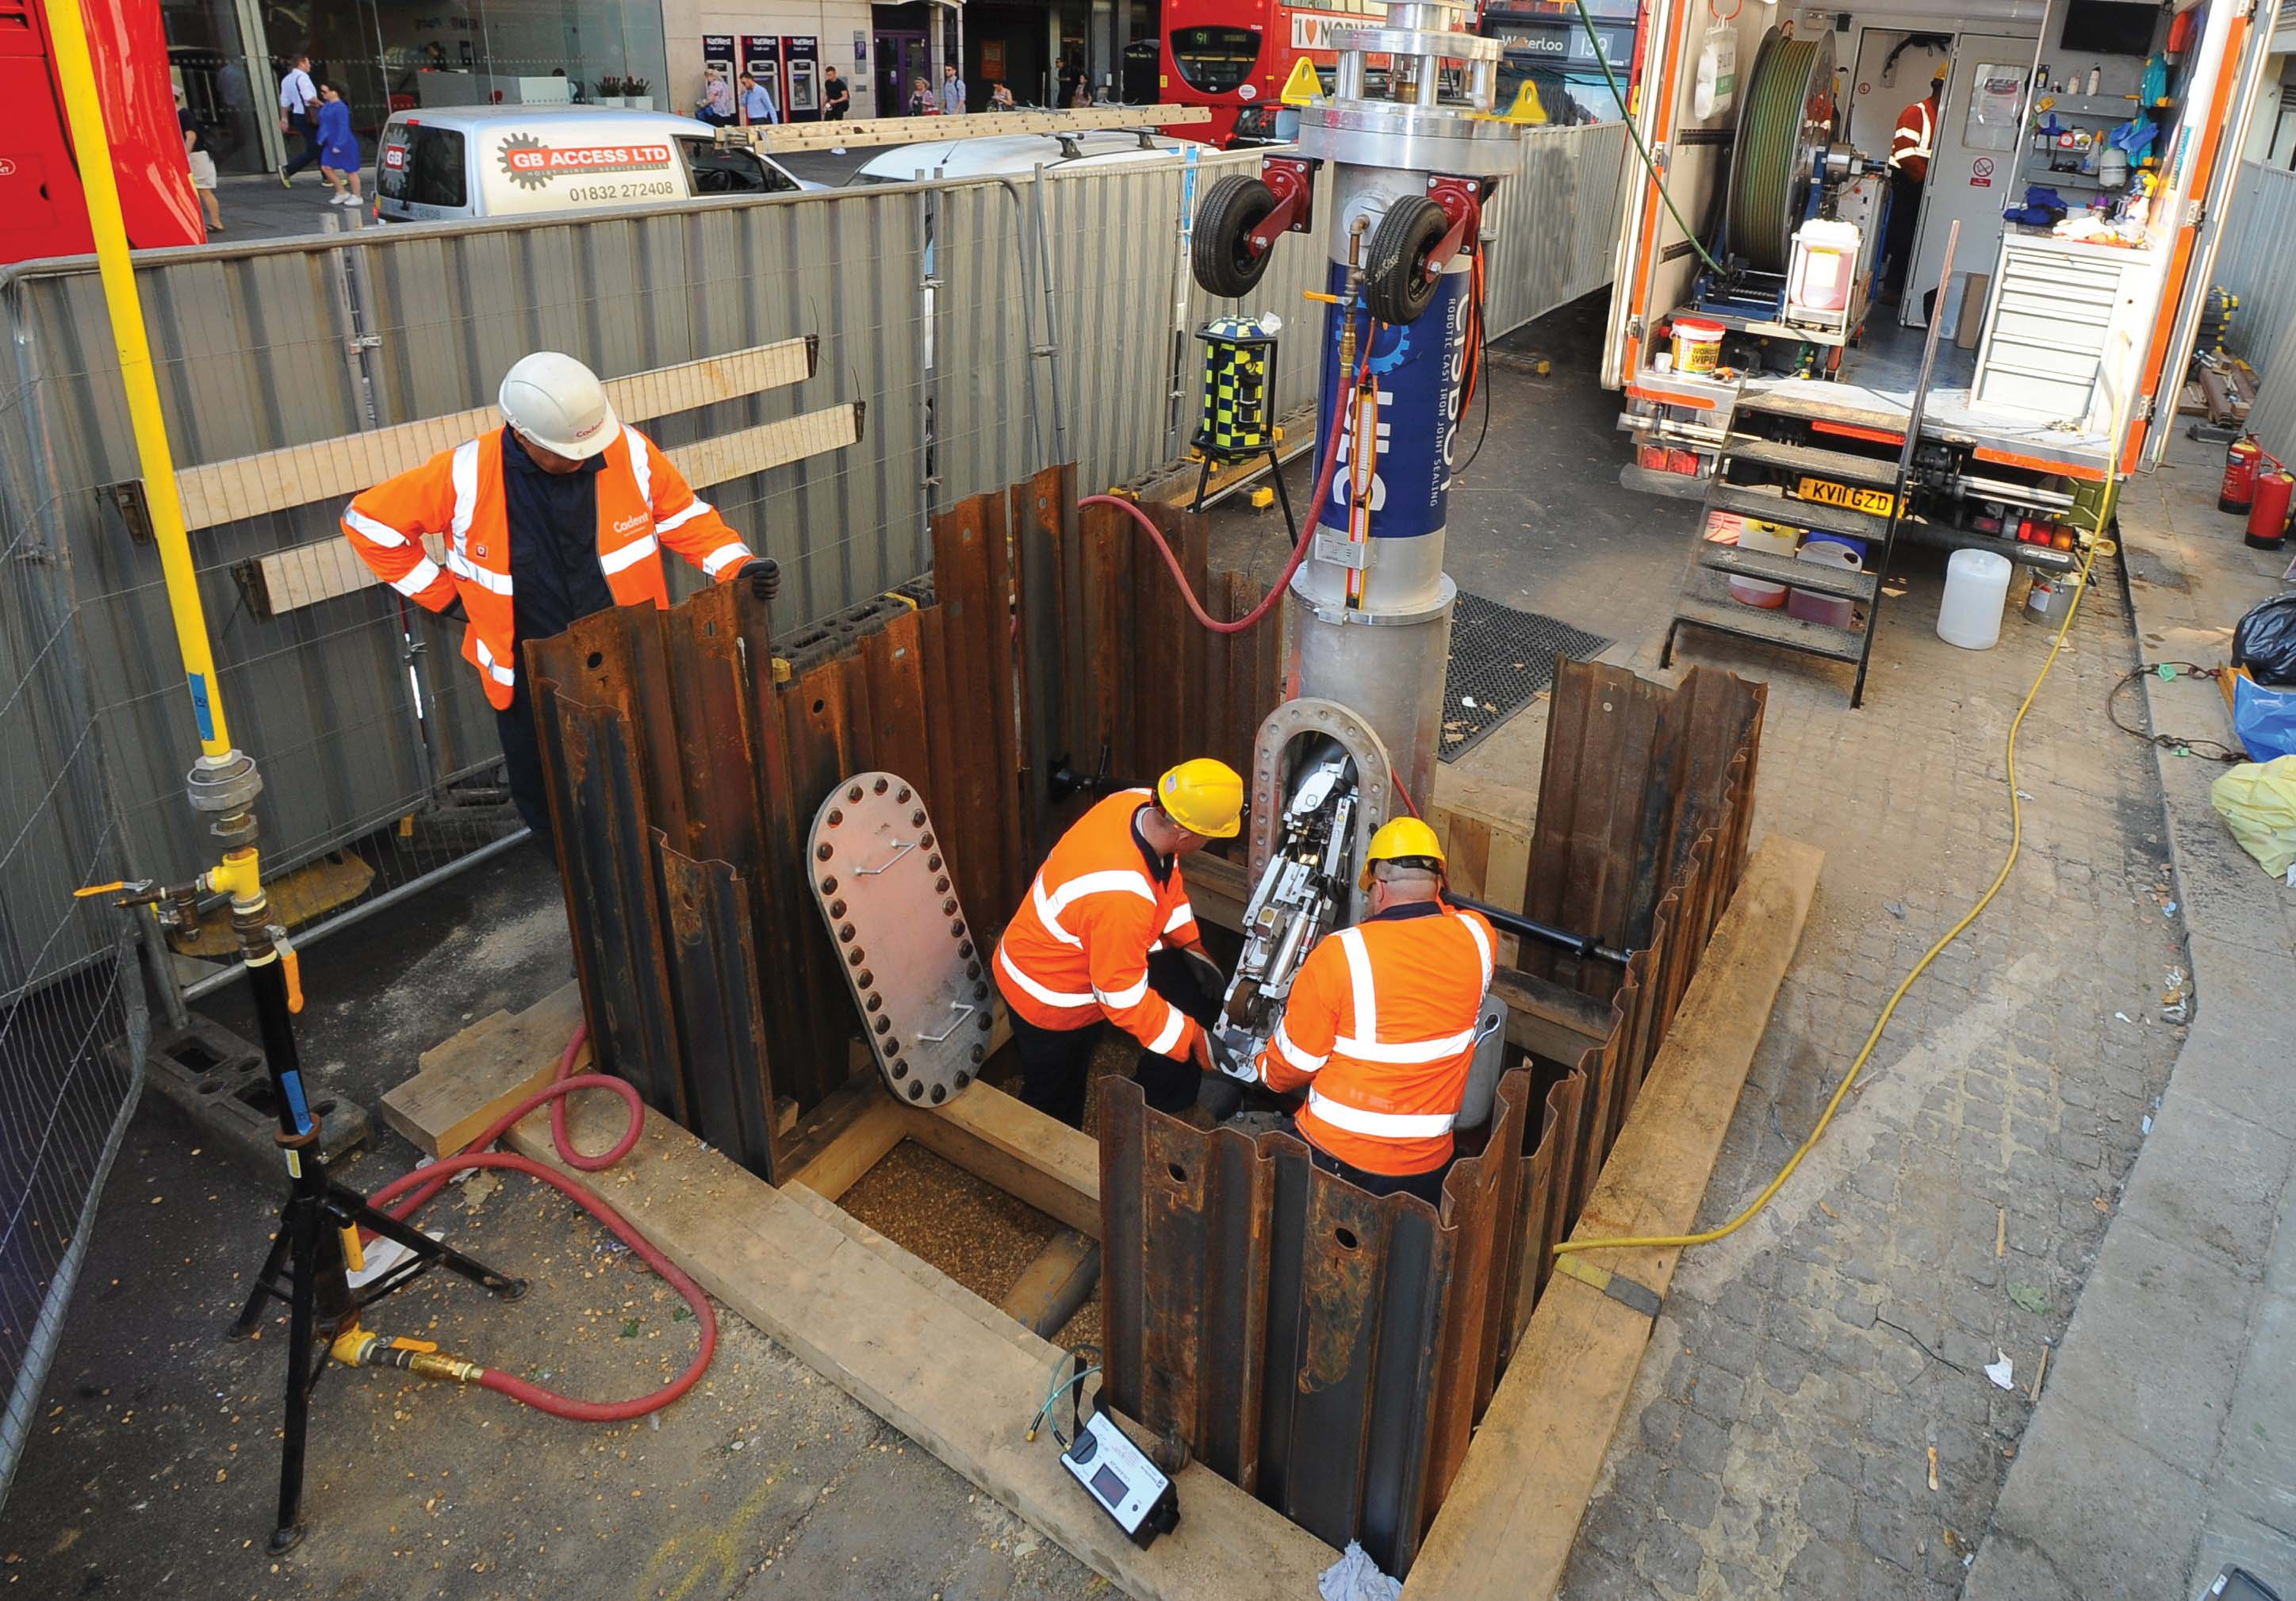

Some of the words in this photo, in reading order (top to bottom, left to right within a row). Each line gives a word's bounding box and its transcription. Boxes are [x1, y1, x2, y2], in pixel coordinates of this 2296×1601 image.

[1196, 33, 1207, 44] 91
[1501, 34, 1563, 52] Werloo
[386, 150, 402, 166] GB
[513, 152, 545, 167] GB
[550, 148, 628, 166] ACCESS
[632, 147, 668, 162] LTD
[569, 185, 617, 201] 01832
[621, 181, 673, 197] 272408
[1443, 297, 1457, 349] ROBOTIC
[1440, 354, 1451, 382] CAST
[1438, 387, 1449, 417] IRON
[1434, 422, 1445, 454] JOINT
[1430, 458, 1443, 507] SEALING
[1851, 490, 1888, 511] GZD
[613, 511, 649, 533] Cadent
